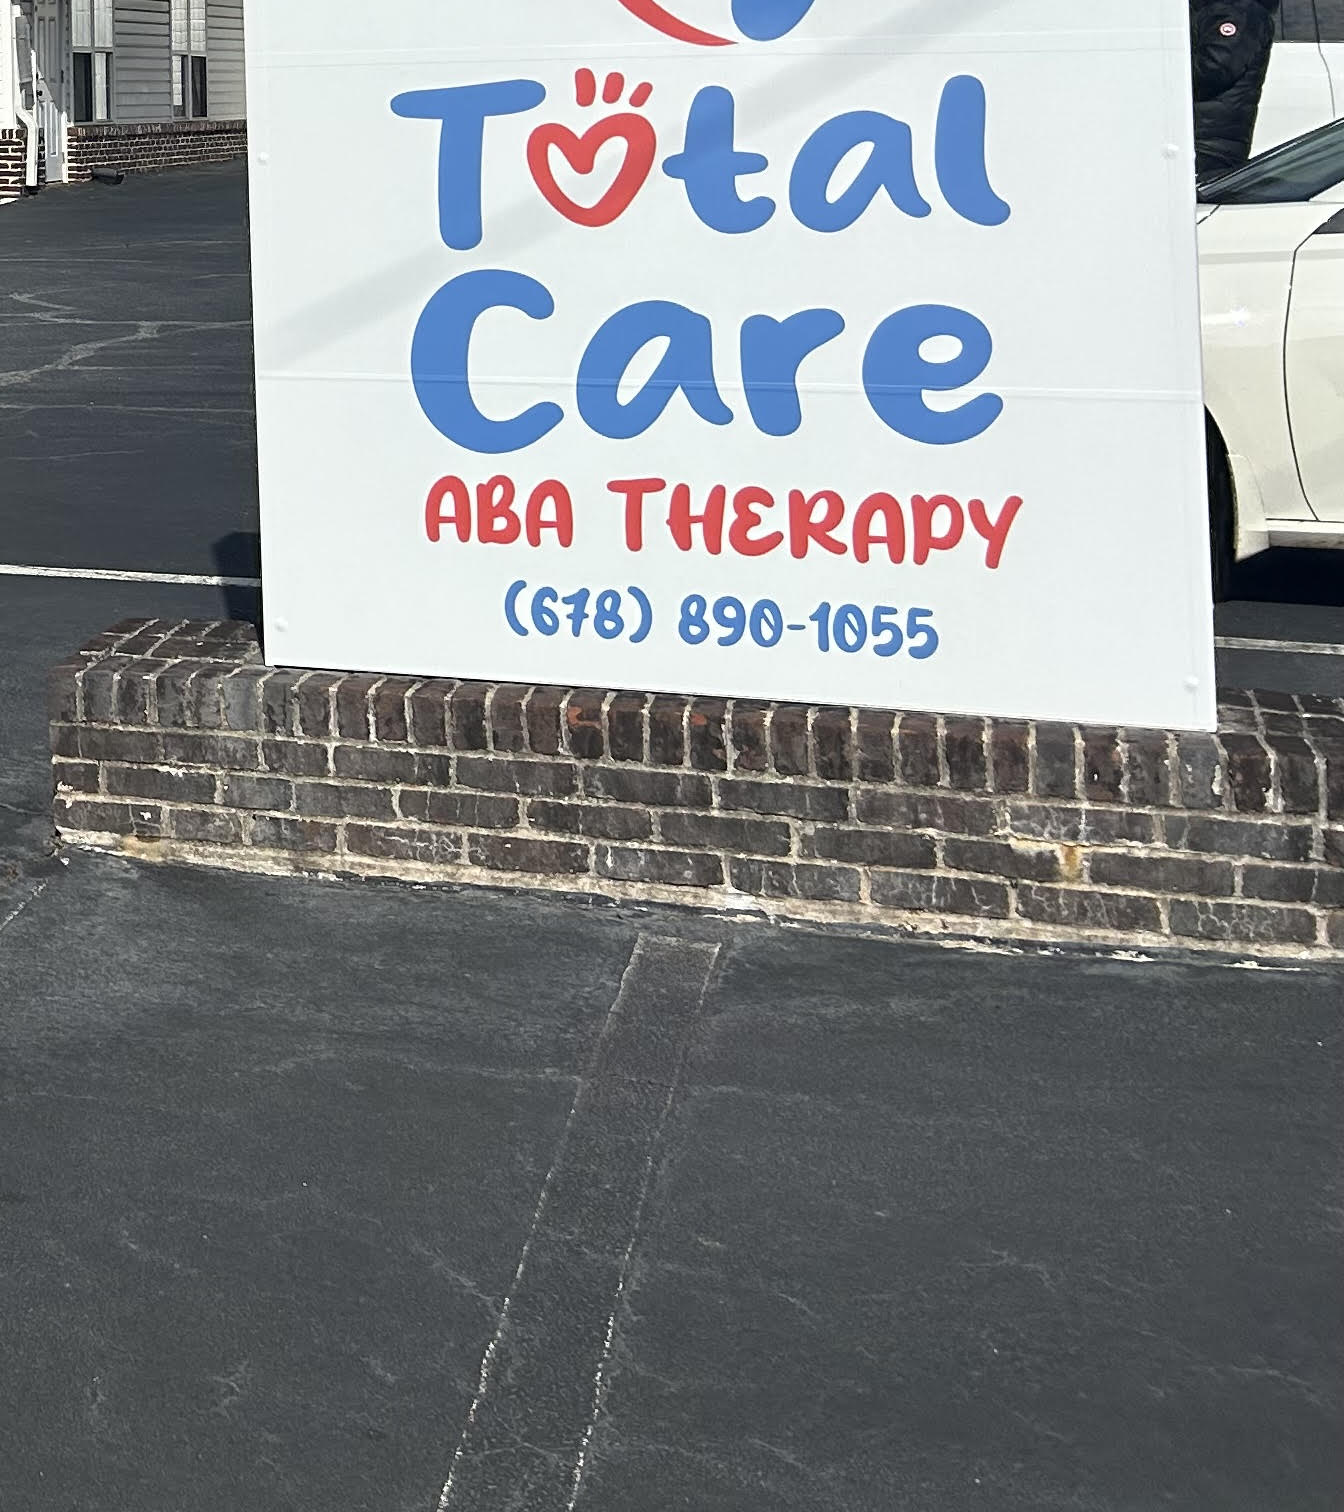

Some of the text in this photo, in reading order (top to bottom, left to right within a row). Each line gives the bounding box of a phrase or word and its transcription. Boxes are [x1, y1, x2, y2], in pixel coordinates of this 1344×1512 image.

[391, 70, 1011, 251] Total
[411, 269, 1003, 454] Care
[425, 474, 1023, 569] ABA THERAPY
[504, 580, 939, 659] (678) 890-1055
